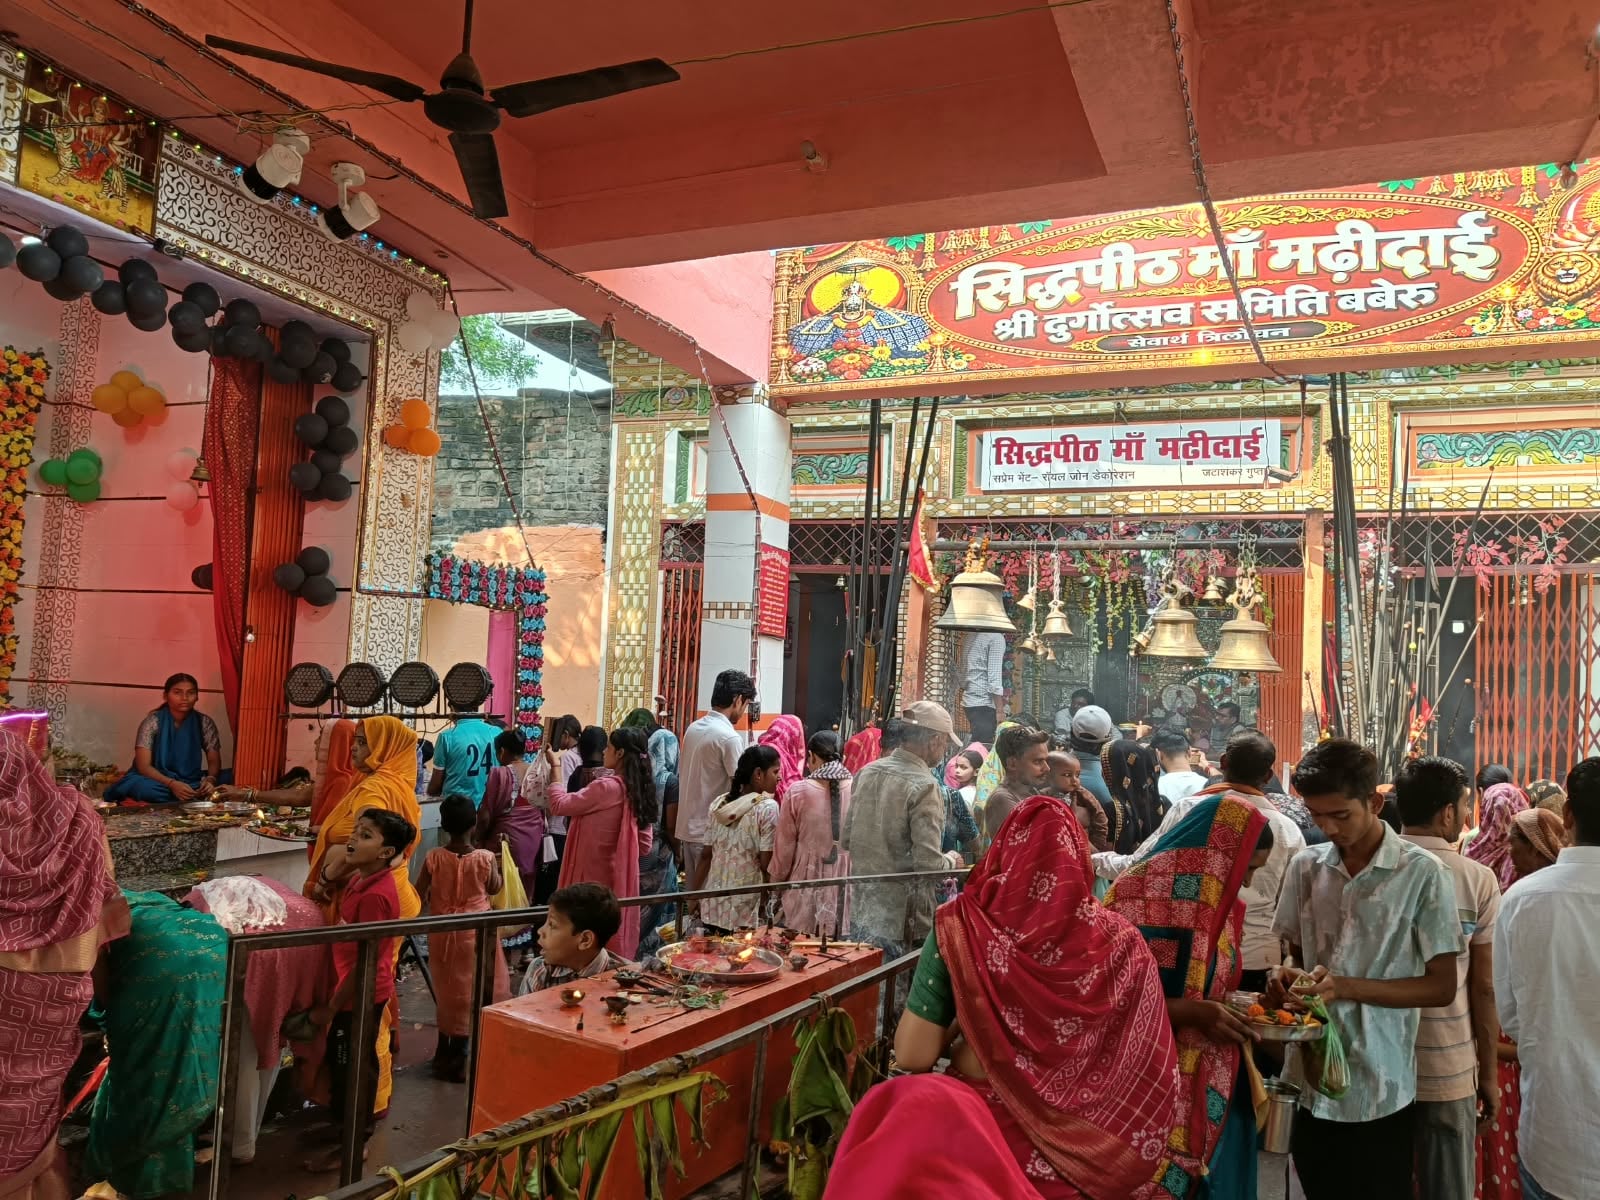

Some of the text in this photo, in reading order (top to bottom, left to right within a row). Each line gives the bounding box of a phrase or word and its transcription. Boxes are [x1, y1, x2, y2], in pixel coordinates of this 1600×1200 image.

[949, 210, 1500, 320] सिद्धपीठ माँ मढ़ीदाई
[993, 309, 1038, 341] श्री
[1043, 301, 1195, 343] दुर्गोत्सव
[1200, 284, 1333, 323] समिति
[1127, 332, 1189, 348] सेवार्थ
[992, 427, 1265, 467] सिद्धपीठ माँ मढ़ीदाई
[992, 472, 1014, 483] सप्रेम
[1069, 469, 1088, 480] जोन
[1092, 468, 1135, 480] डेकोरेशन
[1245, 467, 1266, 478] गुप्त
[466, 742, 493, 777] 24
